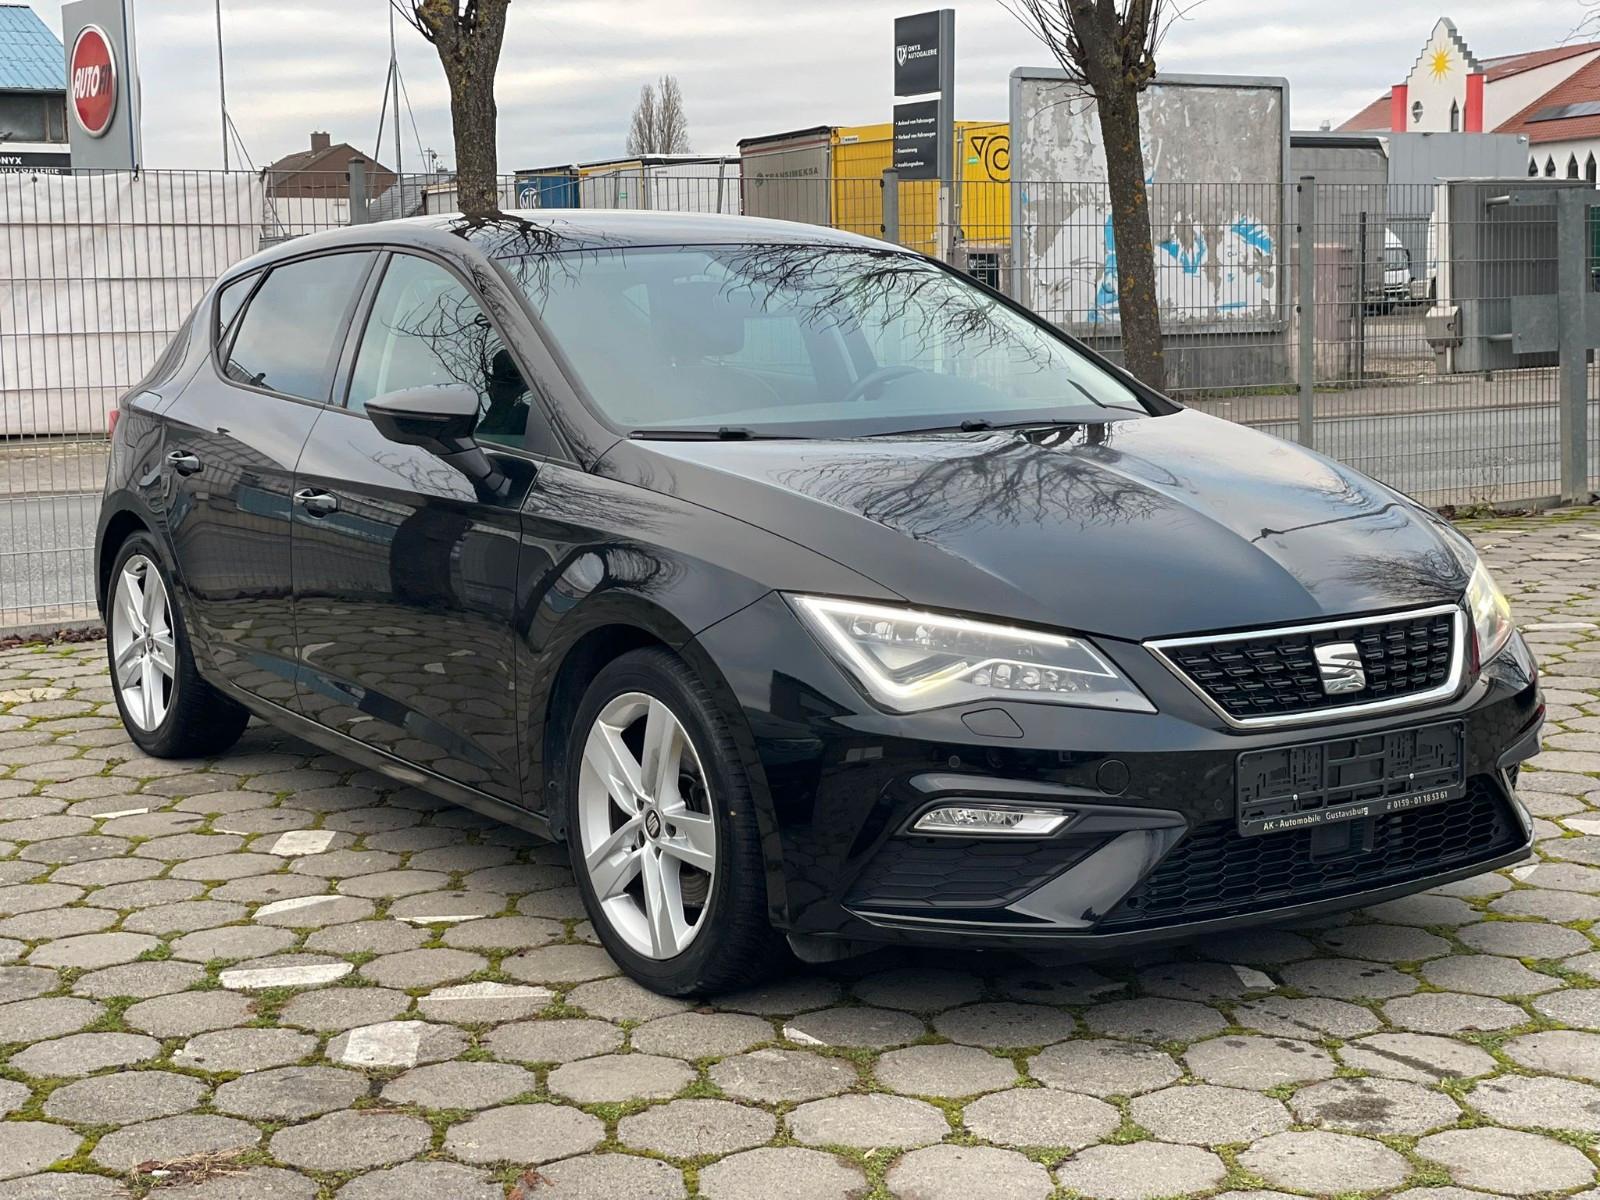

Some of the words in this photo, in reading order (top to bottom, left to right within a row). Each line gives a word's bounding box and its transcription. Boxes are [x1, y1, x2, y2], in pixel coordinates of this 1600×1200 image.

[908, 48, 937, 59] AUTOGALERIE
[0, 156, 22, 165] NYX
[1263, 822, 1274, 831] AK
[1280, 814, 1321, 828] Automobile
[1325, 806, 1369, 820] Gustavsburg
[1393, 798, 1409, 809] 0159
